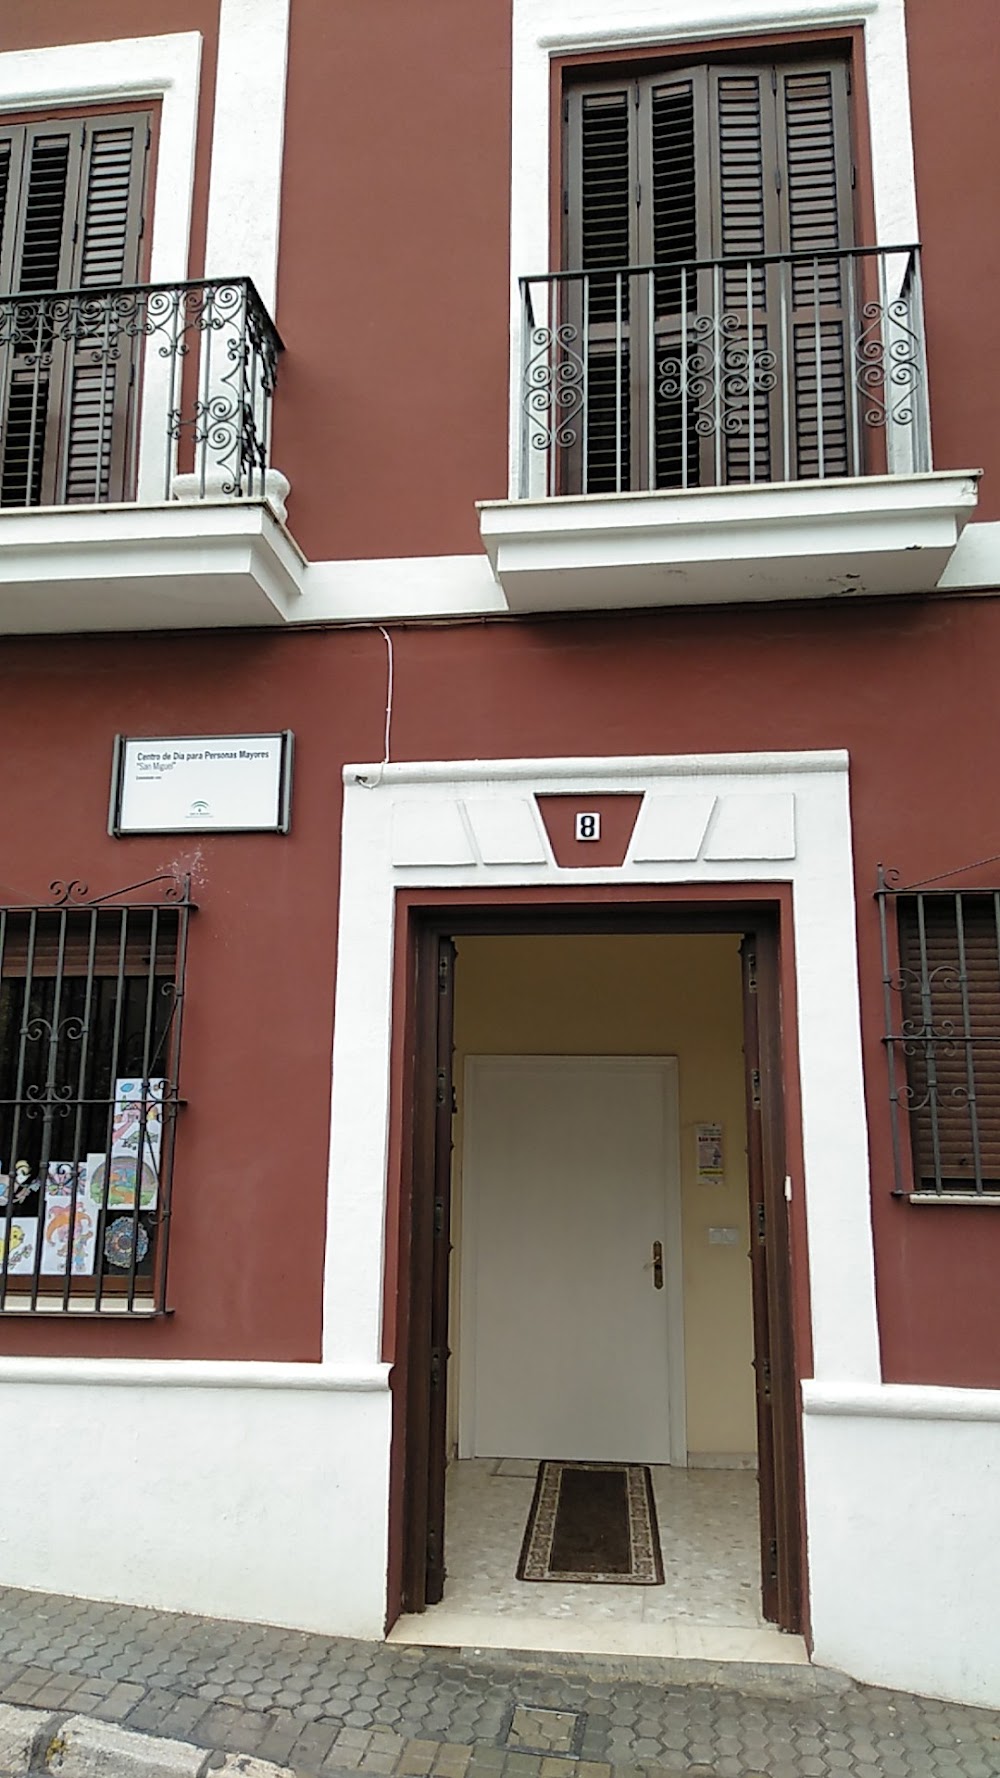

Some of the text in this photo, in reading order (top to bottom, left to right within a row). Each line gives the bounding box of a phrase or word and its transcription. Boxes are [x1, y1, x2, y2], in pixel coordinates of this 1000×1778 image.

[137, 752, 161, 761] Centro
[162, 752, 171, 760] de
[186, 753, 203, 762] para
[204, 751, 237, 760] Personas
[239, 750, 269, 761] Mayores
[580, 815, 595, 838] 8
